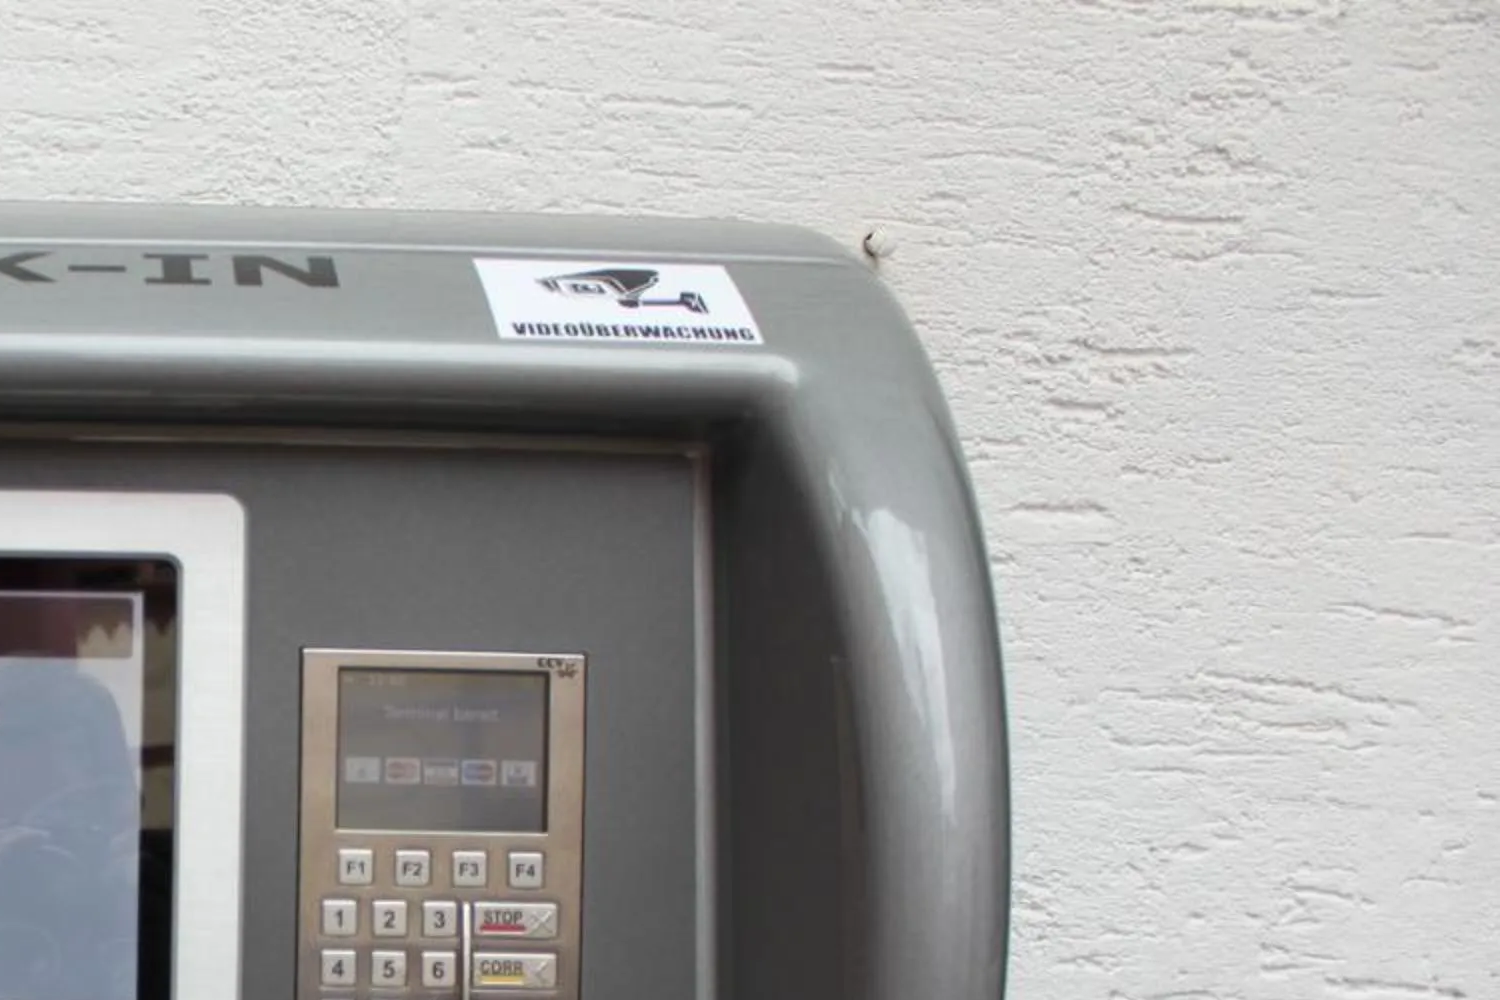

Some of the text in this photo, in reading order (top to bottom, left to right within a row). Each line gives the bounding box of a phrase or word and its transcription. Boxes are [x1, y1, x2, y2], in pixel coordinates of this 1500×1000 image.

[512, 320, 755, 341] VIDEOÜBERWACHUNG
[346, 861, 366, 875] F1
[403, 862, 422, 876] F2
[459, 862, 479, 876] F3
[516, 863, 535, 878] F4
[336, 911, 343, 927] 1
[384, 911, 395, 928] 2
[435, 911, 445, 928] 3
[484, 910, 523, 925] STOP
[332, 960, 344, 977] 4
[383, 961, 395, 978] 5
[433, 962, 444, 979] 6
[480, 960, 523, 976] CORR
